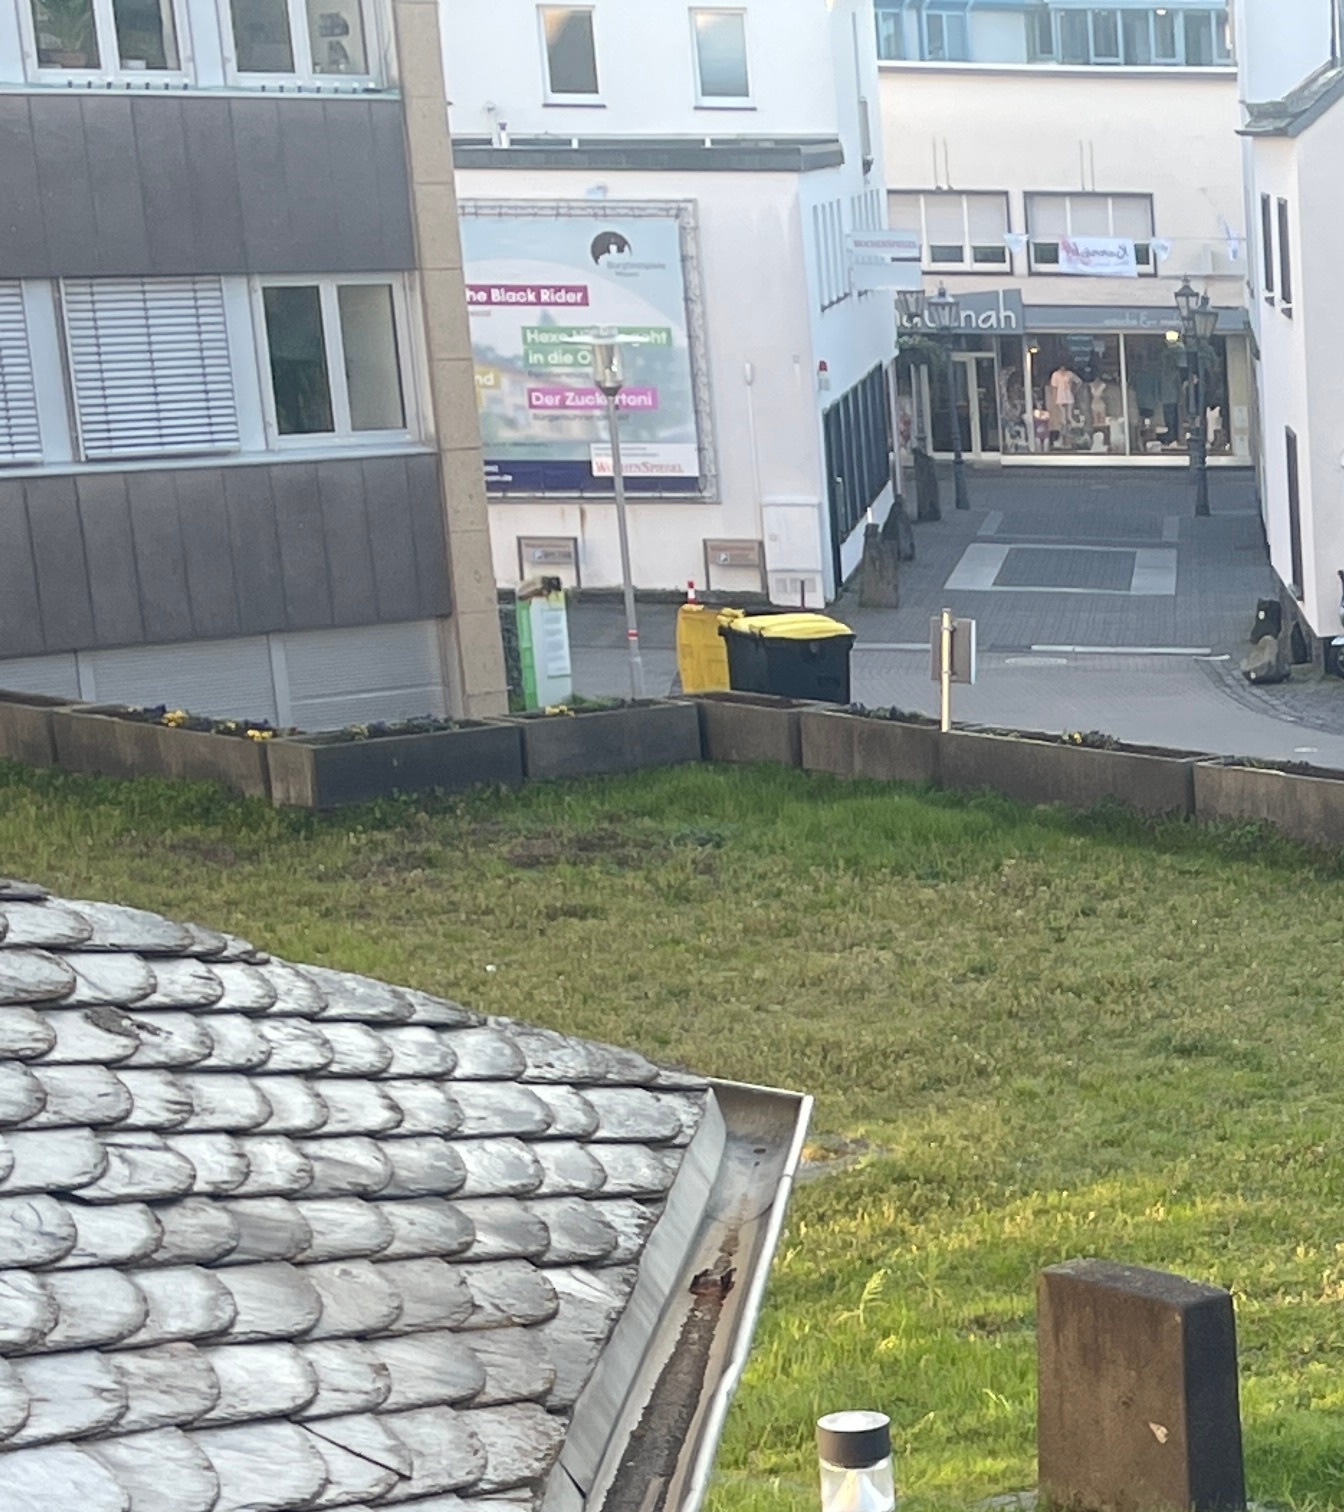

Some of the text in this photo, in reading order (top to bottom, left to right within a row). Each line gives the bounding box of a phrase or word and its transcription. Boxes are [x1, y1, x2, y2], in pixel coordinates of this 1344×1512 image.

[465, 287, 584, 303] he Black Rider
[526, 329, 565, 344] Hexe
[528, 349, 544, 364] in
[547, 349, 574, 365] die
[531, 391, 653, 407] Der Zuckrtoni
